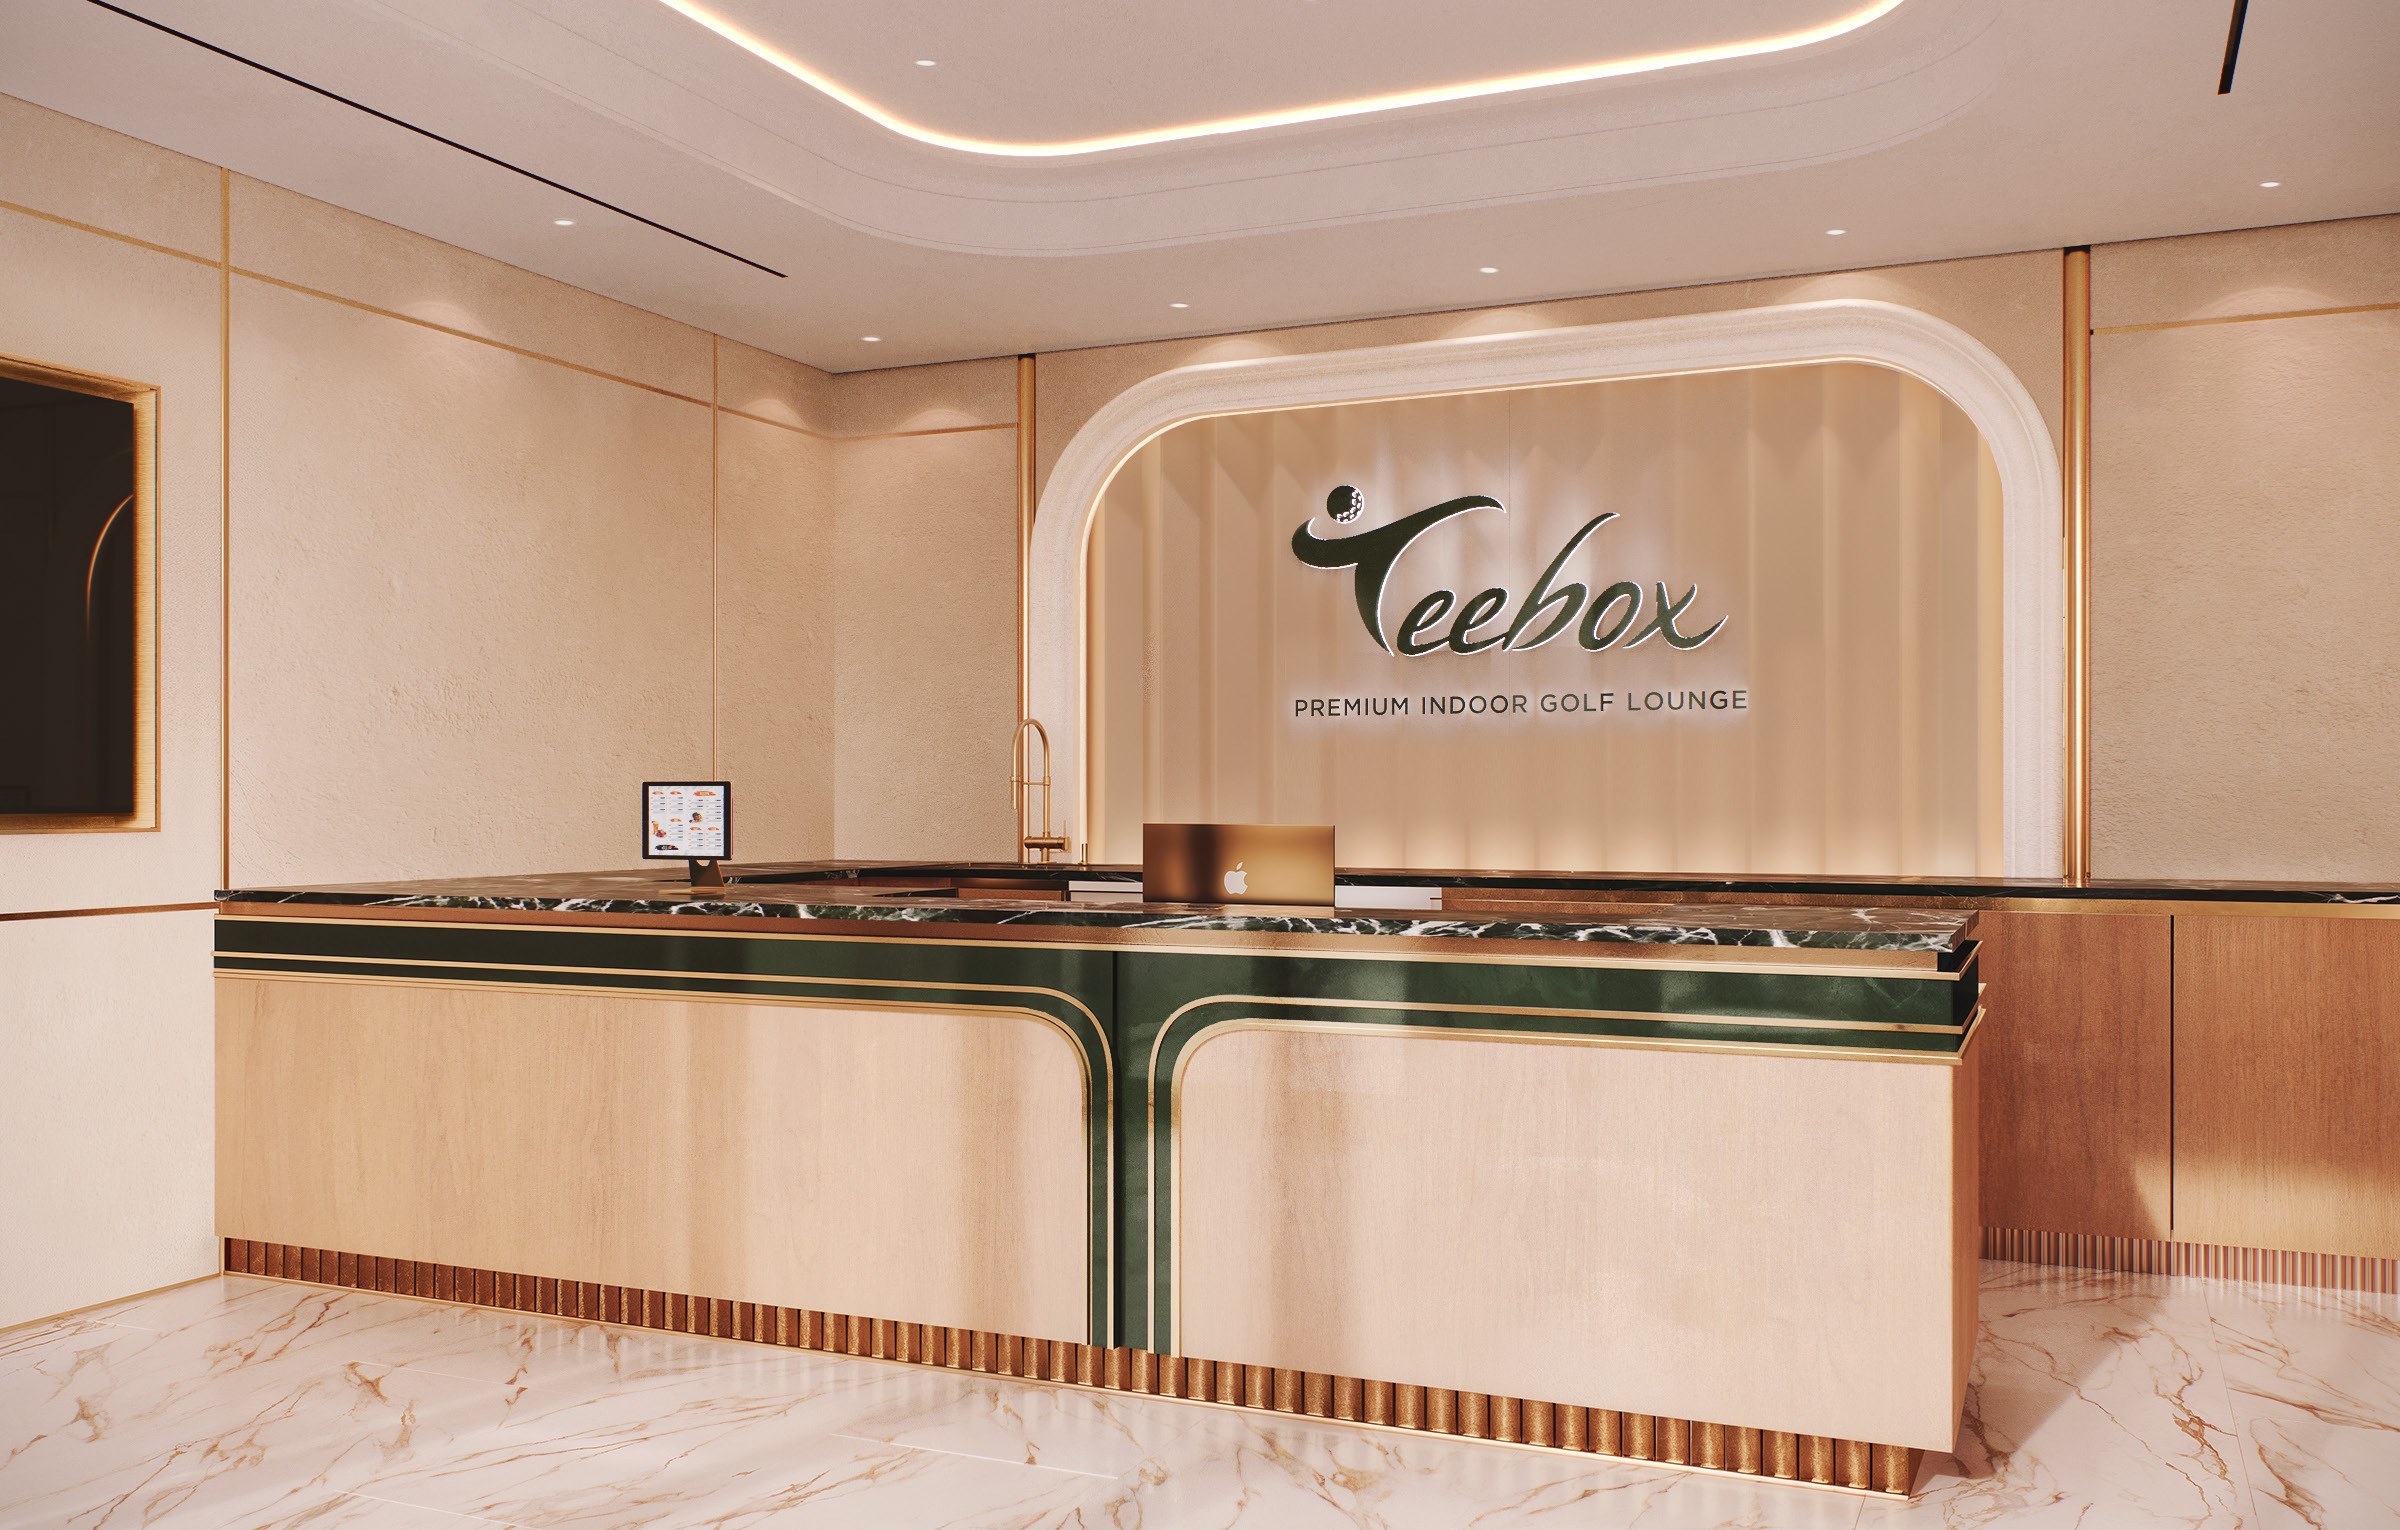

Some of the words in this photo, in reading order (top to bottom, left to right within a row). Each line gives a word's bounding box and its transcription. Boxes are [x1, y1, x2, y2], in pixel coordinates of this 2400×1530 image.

[1291, 494, 1729, 657] Teebox
[1295, 697, 1409, 717] PREMIUM
[1422, 694, 1528, 715] INDOOR
[1540, 692, 1614, 713] GOLF
[1627, 690, 1748, 711] LOUNGE
